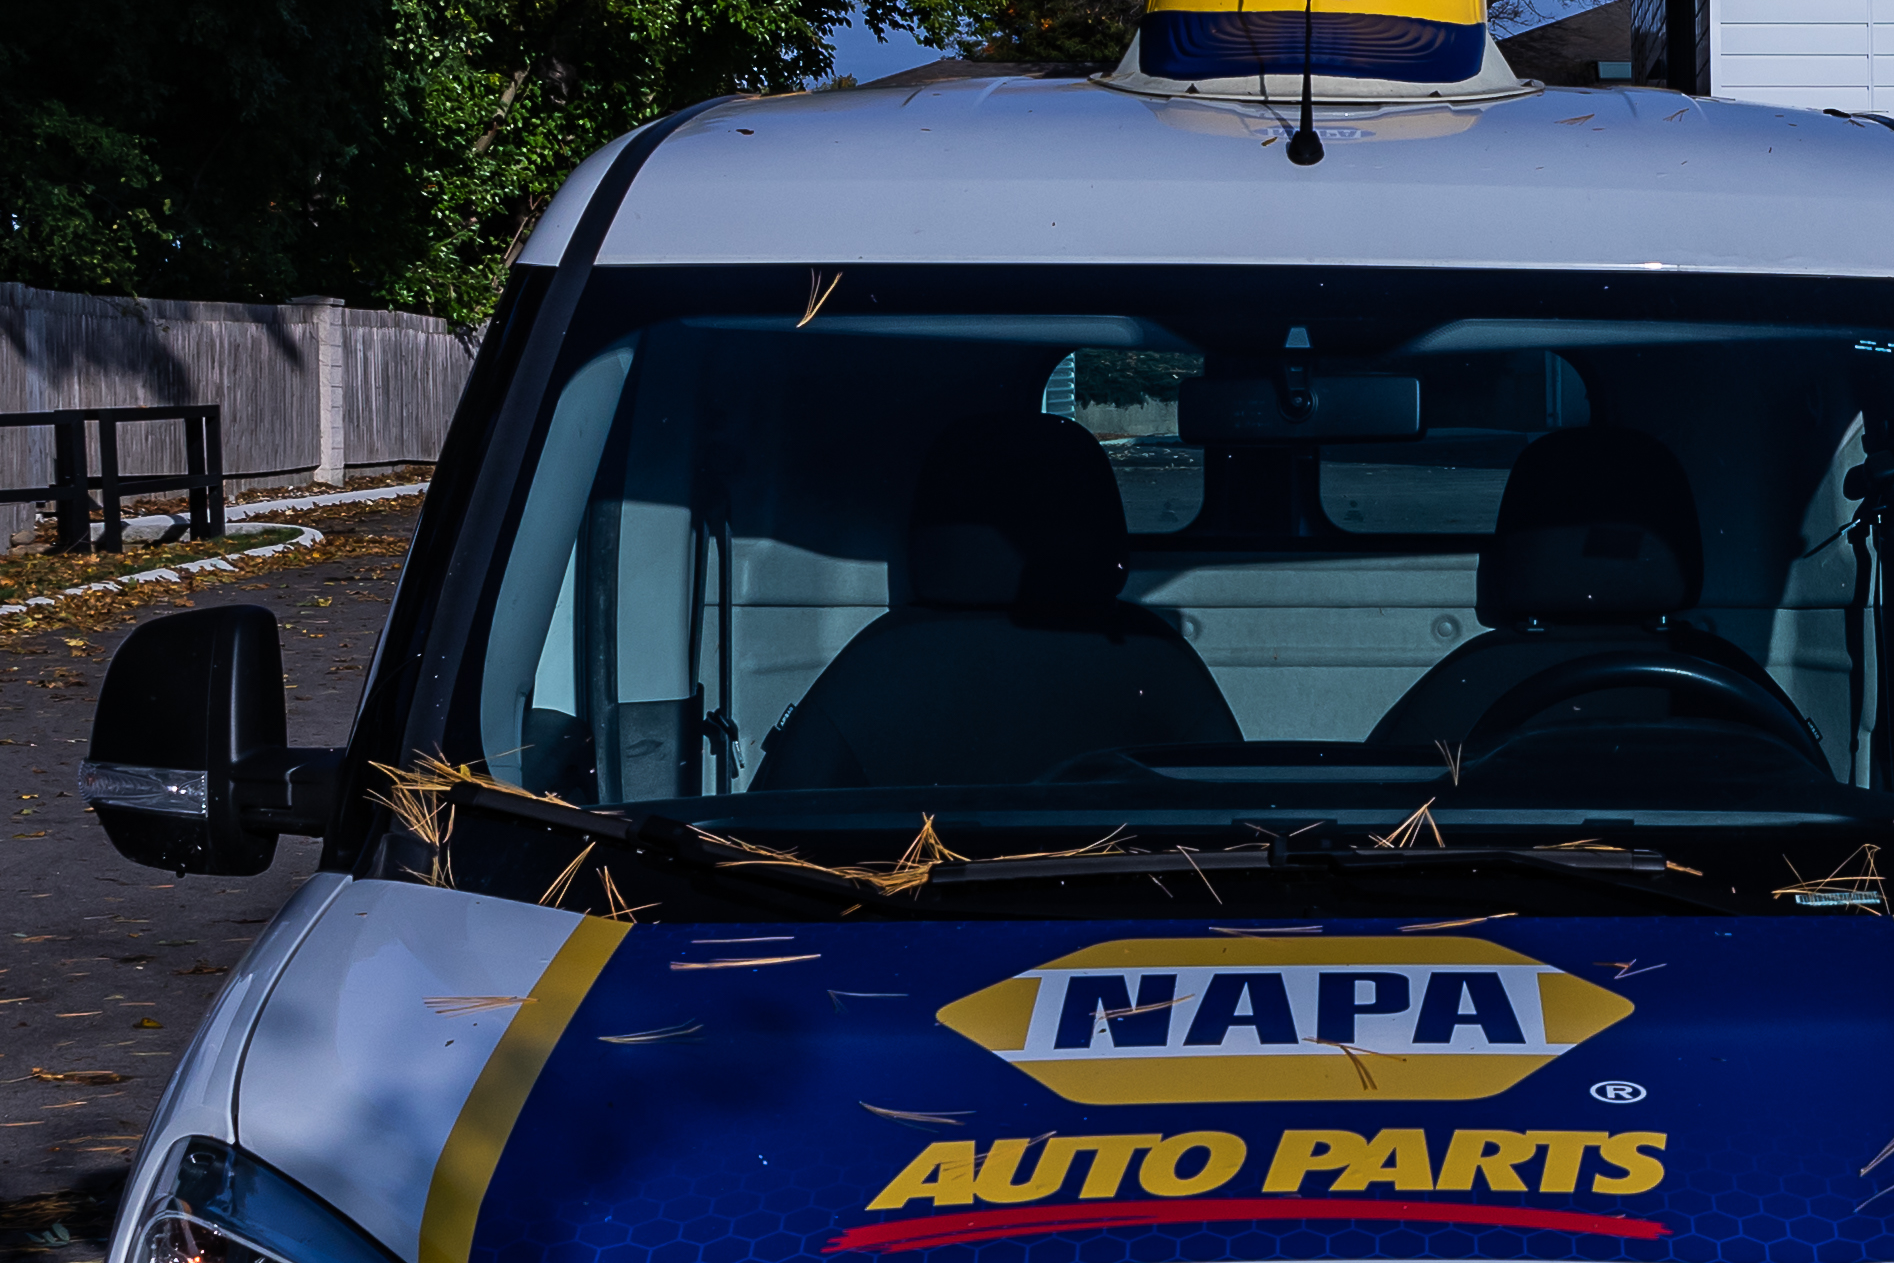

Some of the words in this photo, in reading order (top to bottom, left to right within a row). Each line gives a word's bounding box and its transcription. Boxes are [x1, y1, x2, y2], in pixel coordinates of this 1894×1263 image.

[1053, 970, 1528, 1050] NAPA
[865, 1134, 1247, 1210] AUTO
[1260, 1128, 1668, 1195] PARTS
